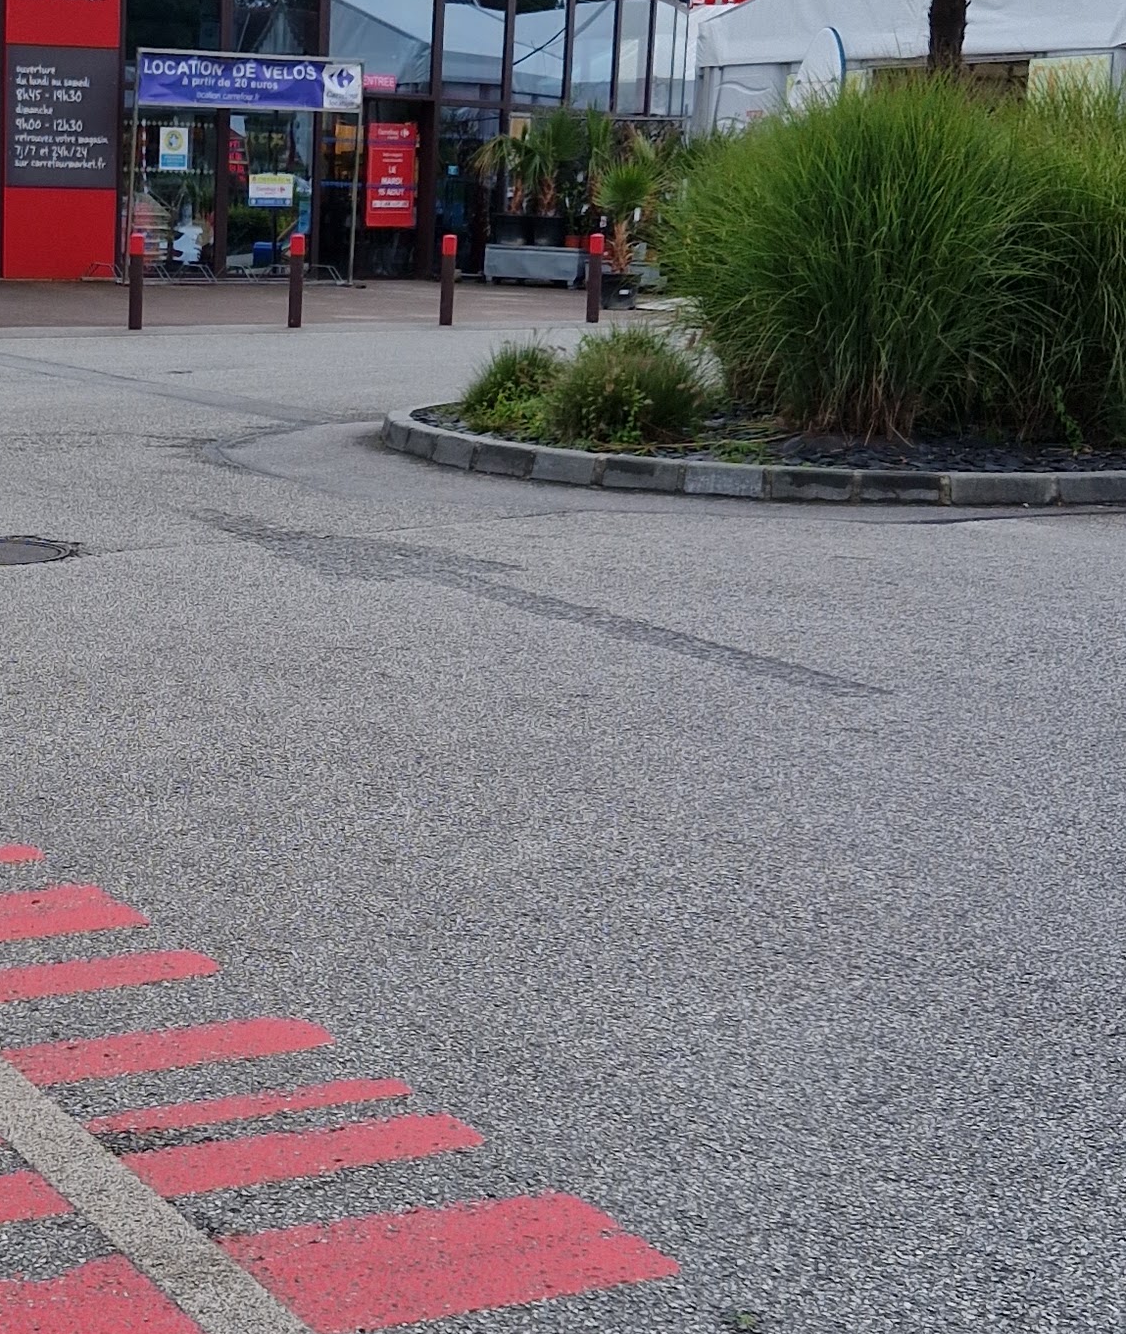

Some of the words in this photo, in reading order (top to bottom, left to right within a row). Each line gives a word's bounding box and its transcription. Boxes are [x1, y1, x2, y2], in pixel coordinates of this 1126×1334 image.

[16, 64, 56, 75] ouverture
[143, 59, 225, 77] LOCATION
[232, 63, 257, 78] DE
[262, 64, 318, 81] VELOS
[15, 74, 27, 85] du
[29, 74, 50, 86] lundi
[63, 76, 90, 88] samedi
[181, 76, 189, 86] à
[217, 77, 231, 88] de
[234, 78, 248, 88] 20
[250, 79, 279, 90] euros
[15, 88, 42, 102] 8h45
[53, 89, 83, 103] 19h30
[15, 103, 54, 115] dimanche
[15, 117, 42, 131] 9h00
[53, 118, 84, 132] 12h30
[14, 132, 54, 143] retrouvez
[55, 133, 76, 144] votre
[77, 136, 109, 147] magasin
[14, 145, 36, 159] 7j/7
[39, 147, 49, 157] et
[52, 145, 88, 158] 24h/24
[14, 159, 28, 168] sur
[30, 157, 107, 170] carrefourmarket.fr
